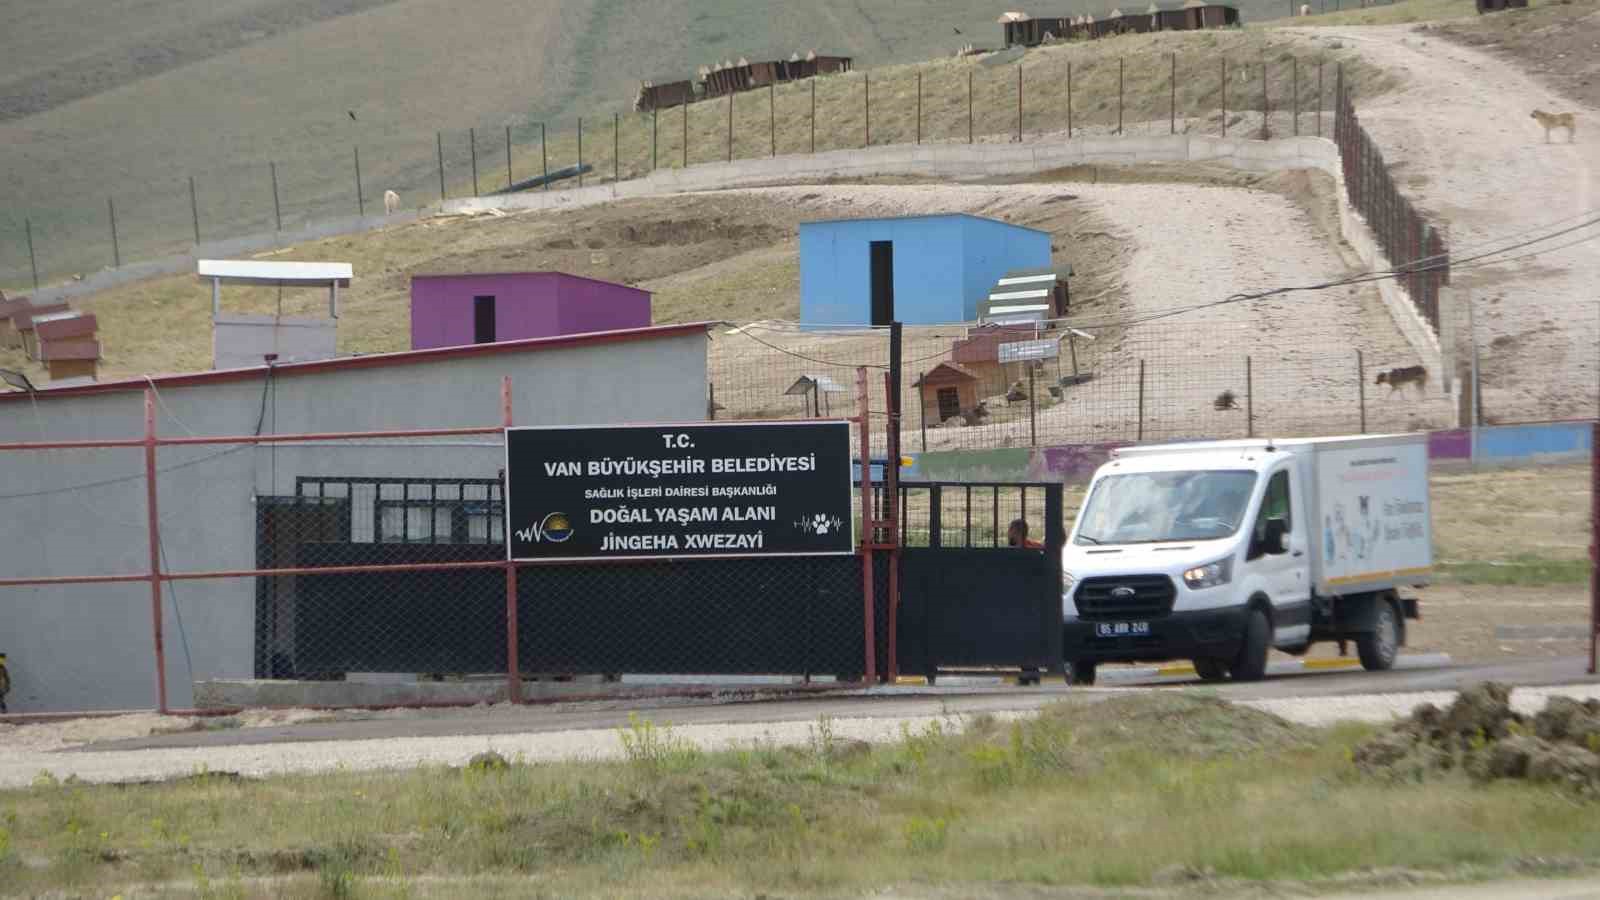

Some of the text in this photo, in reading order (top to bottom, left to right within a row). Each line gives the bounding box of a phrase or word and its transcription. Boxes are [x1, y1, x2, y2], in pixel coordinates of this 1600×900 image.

[662, 434, 696, 449] T.C.
[544, 452, 816, 479] VAN BÜYÜKŞEHİR BELEDİYESİ
[584, 483, 777, 500] SAĞLIK İŞLERİ DAİRESİ BAŞKANLIĞI
[590, 504, 776, 527] DOĞAL YAŞAM ALANI
[599, 531, 679, 551] JİNGEHA
